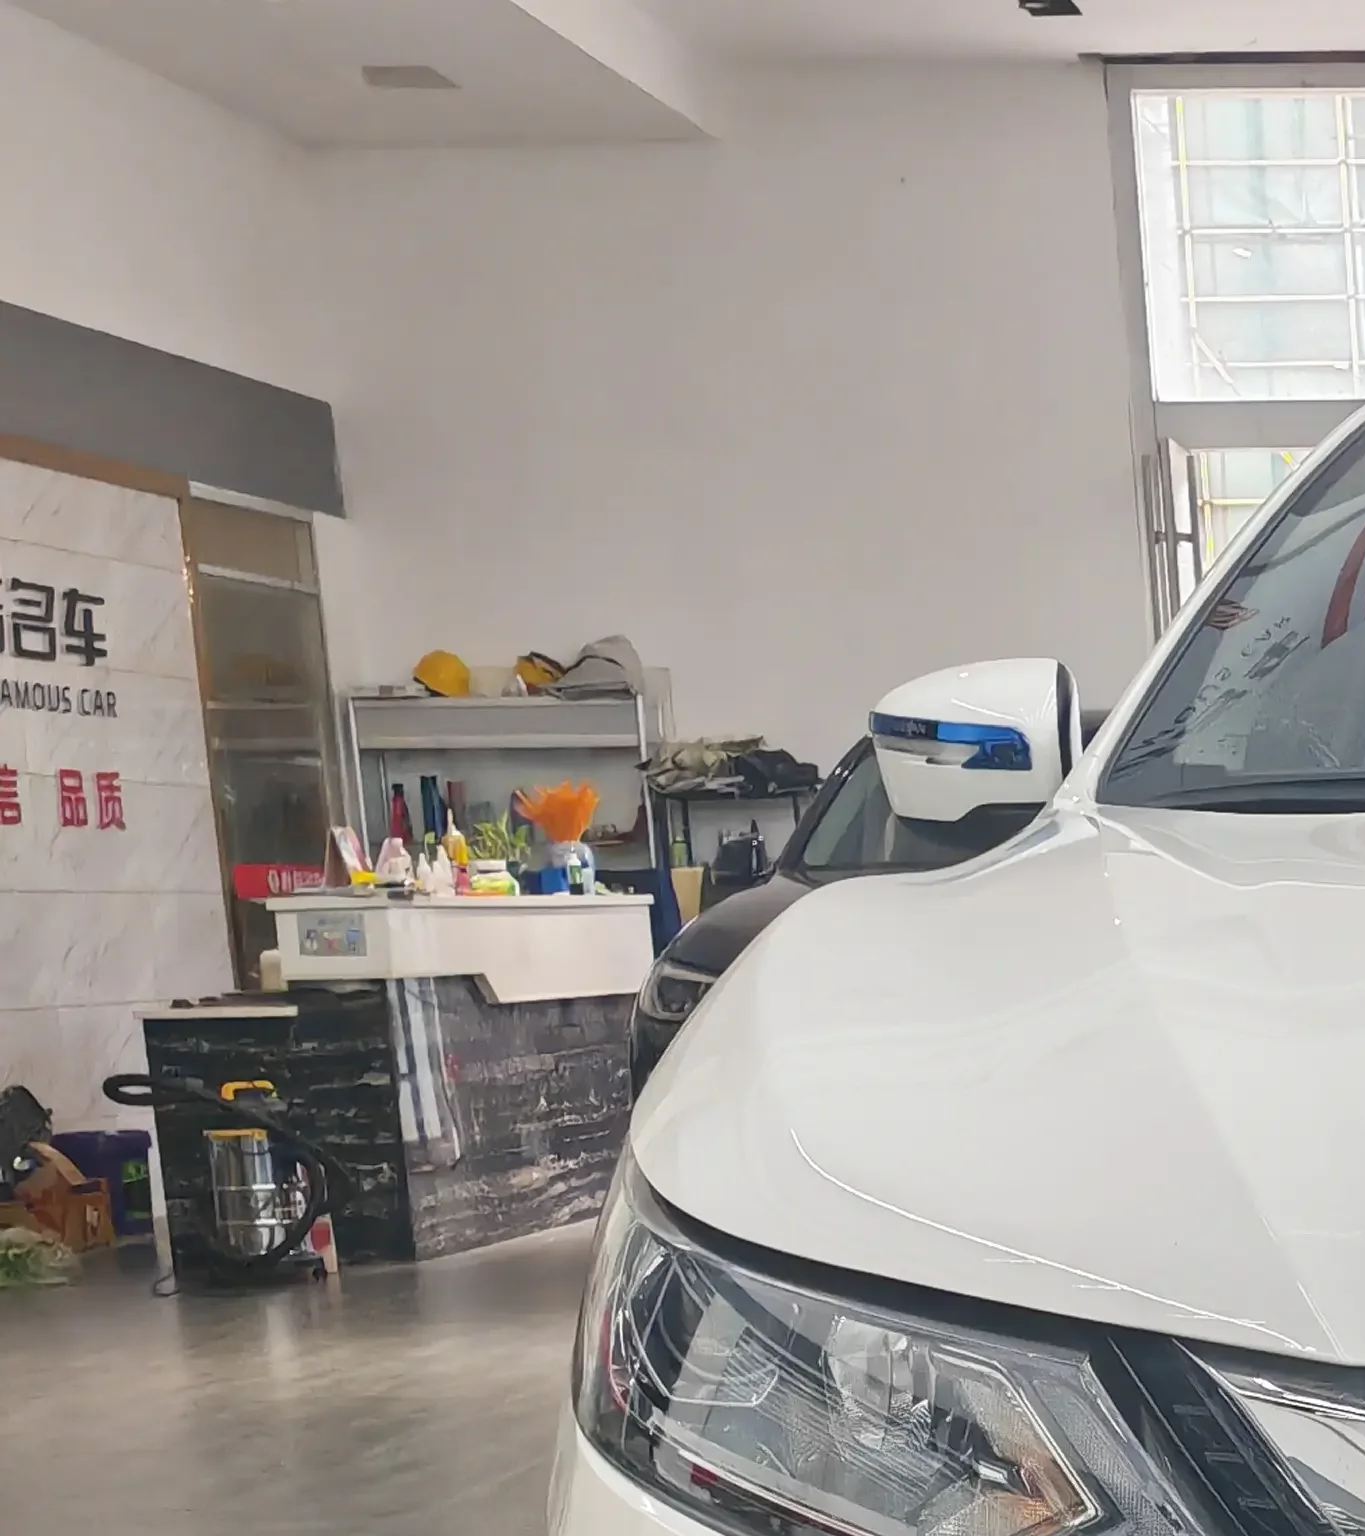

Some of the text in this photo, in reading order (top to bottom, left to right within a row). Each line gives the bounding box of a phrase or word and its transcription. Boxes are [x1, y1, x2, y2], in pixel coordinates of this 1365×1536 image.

[0, 577, 108, 667] 名车
[79, 688, 118, 718] CAR
[58, 768, 127, 831] 品质
